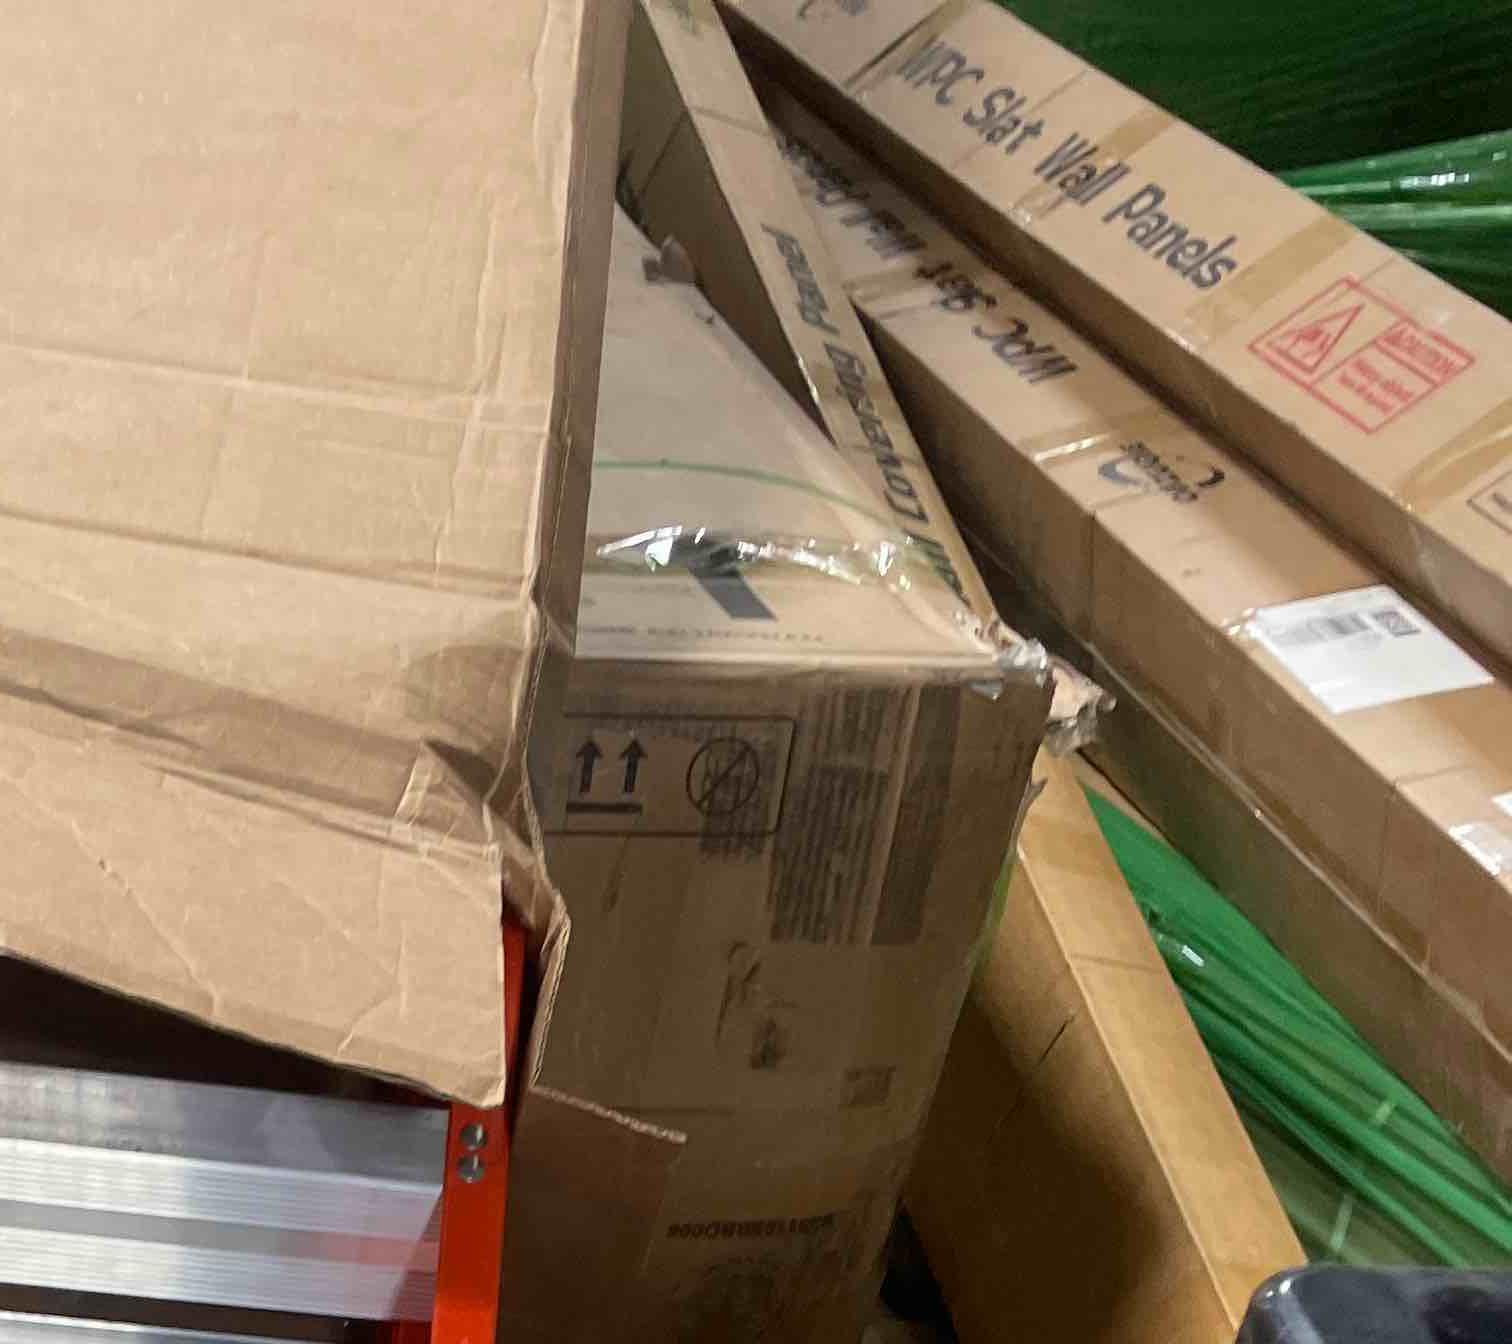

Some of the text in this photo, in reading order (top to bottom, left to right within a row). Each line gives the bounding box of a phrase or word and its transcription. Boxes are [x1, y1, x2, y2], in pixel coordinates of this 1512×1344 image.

[896, 41, 1240, 290] WPC Slat Wall Panels
